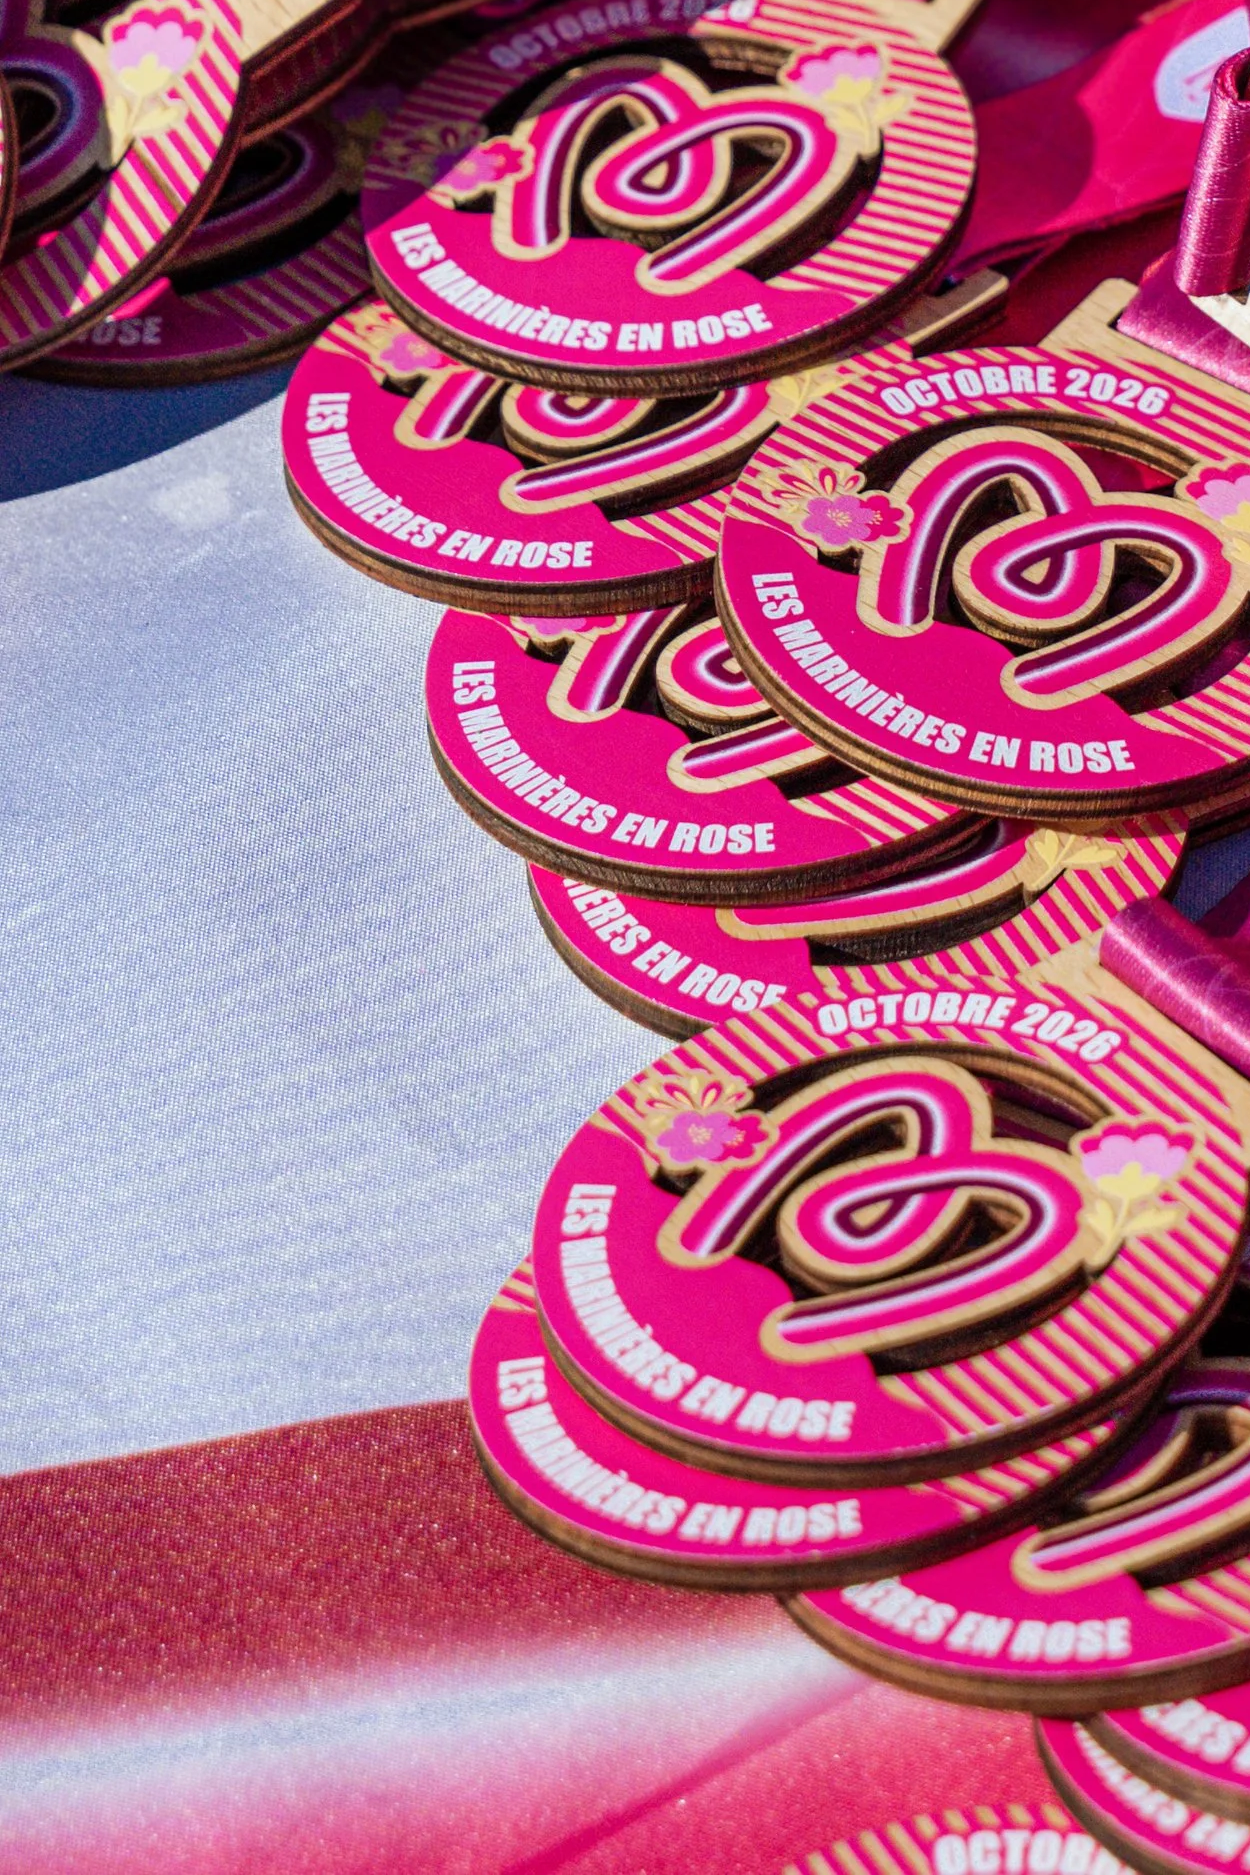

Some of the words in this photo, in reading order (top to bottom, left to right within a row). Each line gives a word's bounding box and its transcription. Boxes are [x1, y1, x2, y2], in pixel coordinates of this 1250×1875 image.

[390, 222, 440, 266] LES
[417, 263, 611, 353] MARINIÈRES
[616, 322, 665, 353] EN
[679, 302, 773, 346] ROSE
[304, 391, 352, 433] LES
[879, 364, 1056, 417] OCTOBRE
[1063, 366, 1171, 417] 2026
[306, 432, 438, 549] MARINIÈRES
[438, 529, 490, 563] EN
[490, 539, 594, 569] ROSE
[751, 571, 805, 619] LES
[452, 660, 496, 706] LES
[772, 616, 961, 754] MARINIÈRES
[456, 702, 611, 833] MARINIÈRES
[968, 733, 1018, 768] EN
[1029, 739, 1136, 775] ROSE
[611, 812, 666, 849] EN
[668, 822, 776, 856] ROSE
[631, 941, 692, 985] EN
[678, 963, 787, 1013] ROSE
[817, 991, 1015, 1038] OCTOBRE
[1010, 1002, 1122, 1065] 2026
[560, 1182, 617, 1237] LES
[559, 1236, 699, 1419] MARINIÈRES
[498, 1355, 549, 1404] LES
[696, 1381, 751, 1423] EN
[741, 1397, 856, 1443] ROSE
[504, 1405, 684, 1545] MARINIÈRES
[679, 1501, 735, 1546] EN
[743, 1499, 863, 1546] ROSE
[945, 1610, 1014, 1657] EN
[1008, 1616, 1131, 1663] ROSE
